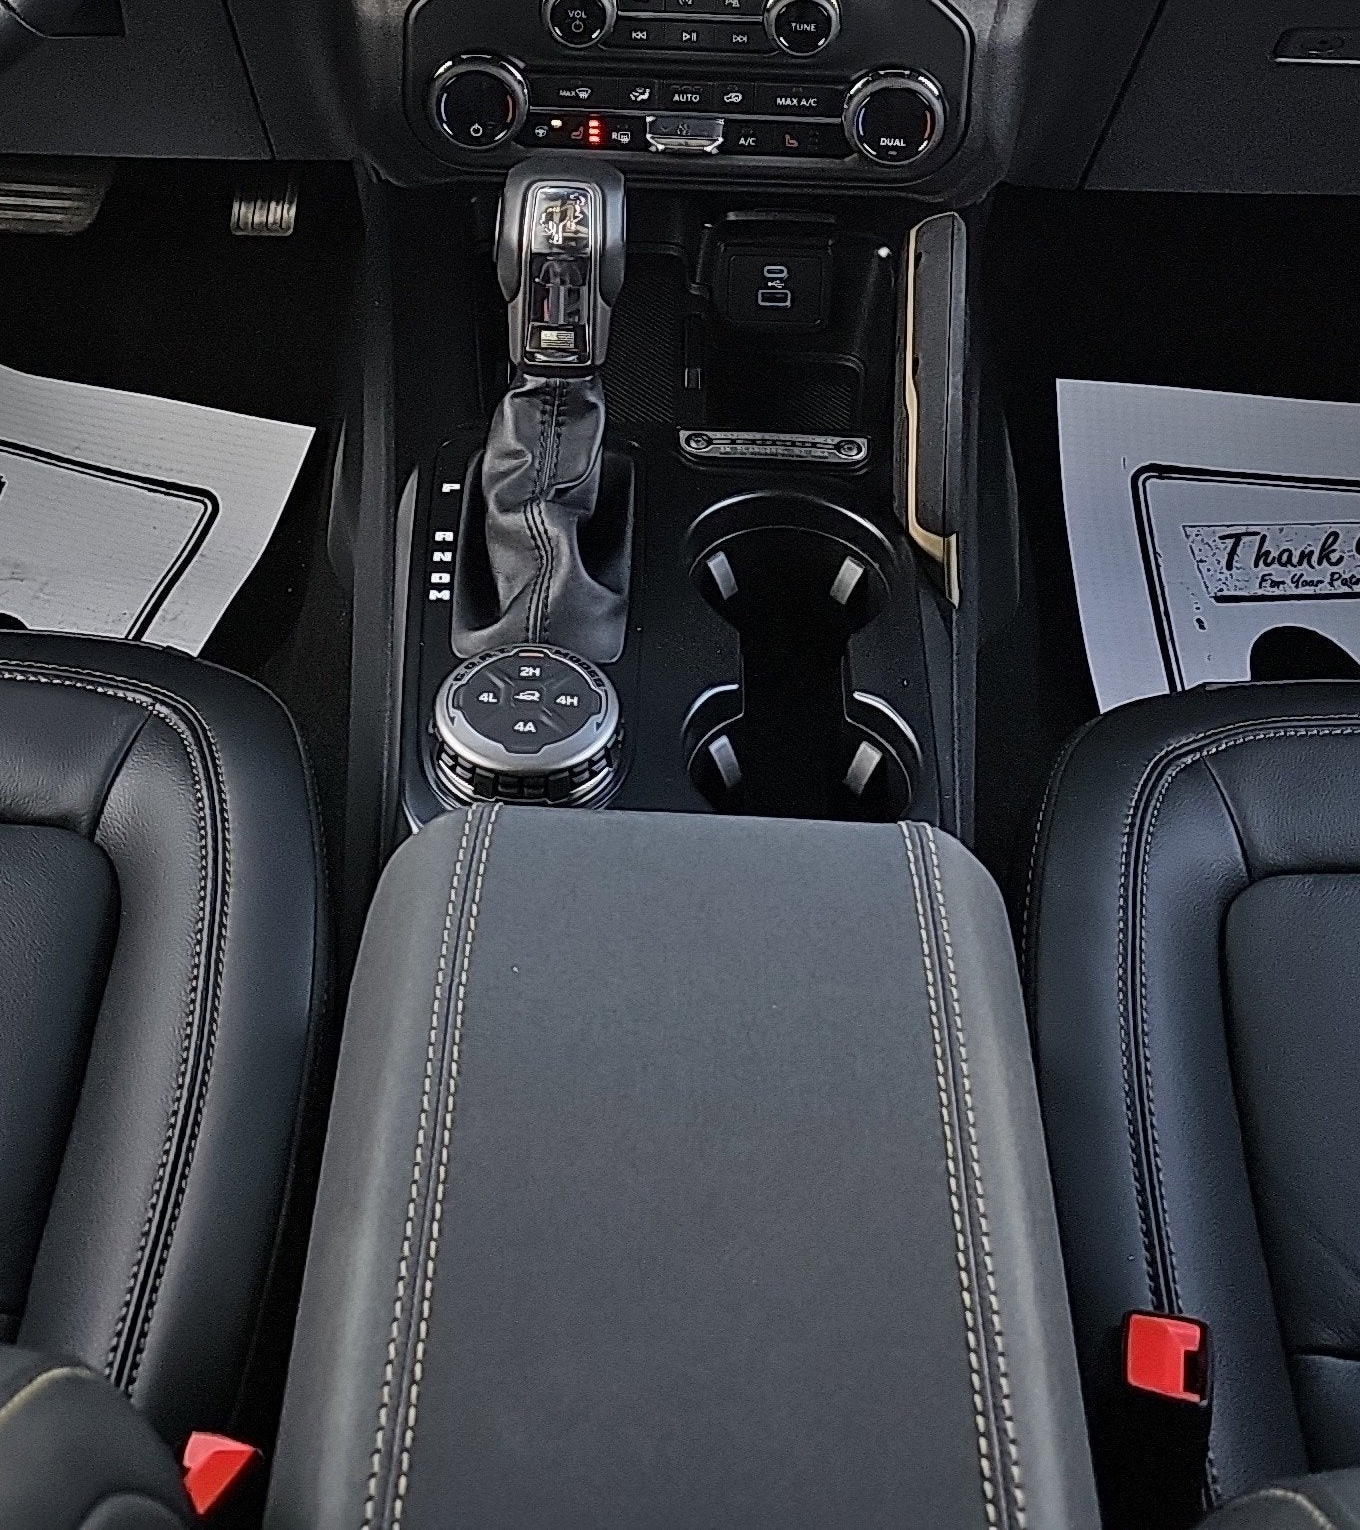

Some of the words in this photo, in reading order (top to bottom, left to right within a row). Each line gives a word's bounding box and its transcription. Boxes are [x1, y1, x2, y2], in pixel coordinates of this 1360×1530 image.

[568, 10, 587, 19] VOL
[791, 22, 817, 32] TUNE
[673, 93, 700, 103] AUTO
[776, 97, 798, 107] MAX
[800, 97, 818, 107] A/C
[739, 136, 757, 146] A/C
[879, 137, 907, 148] DUAL
[1218, 528, 1344, 572] Thank
[1258, 573, 1286, 589] For
[519, 666, 542, 677] 2H
[477, 692, 498, 703] 4L
[555, 695, 579, 707] 4H
[513, 721, 537, 733] 4A
